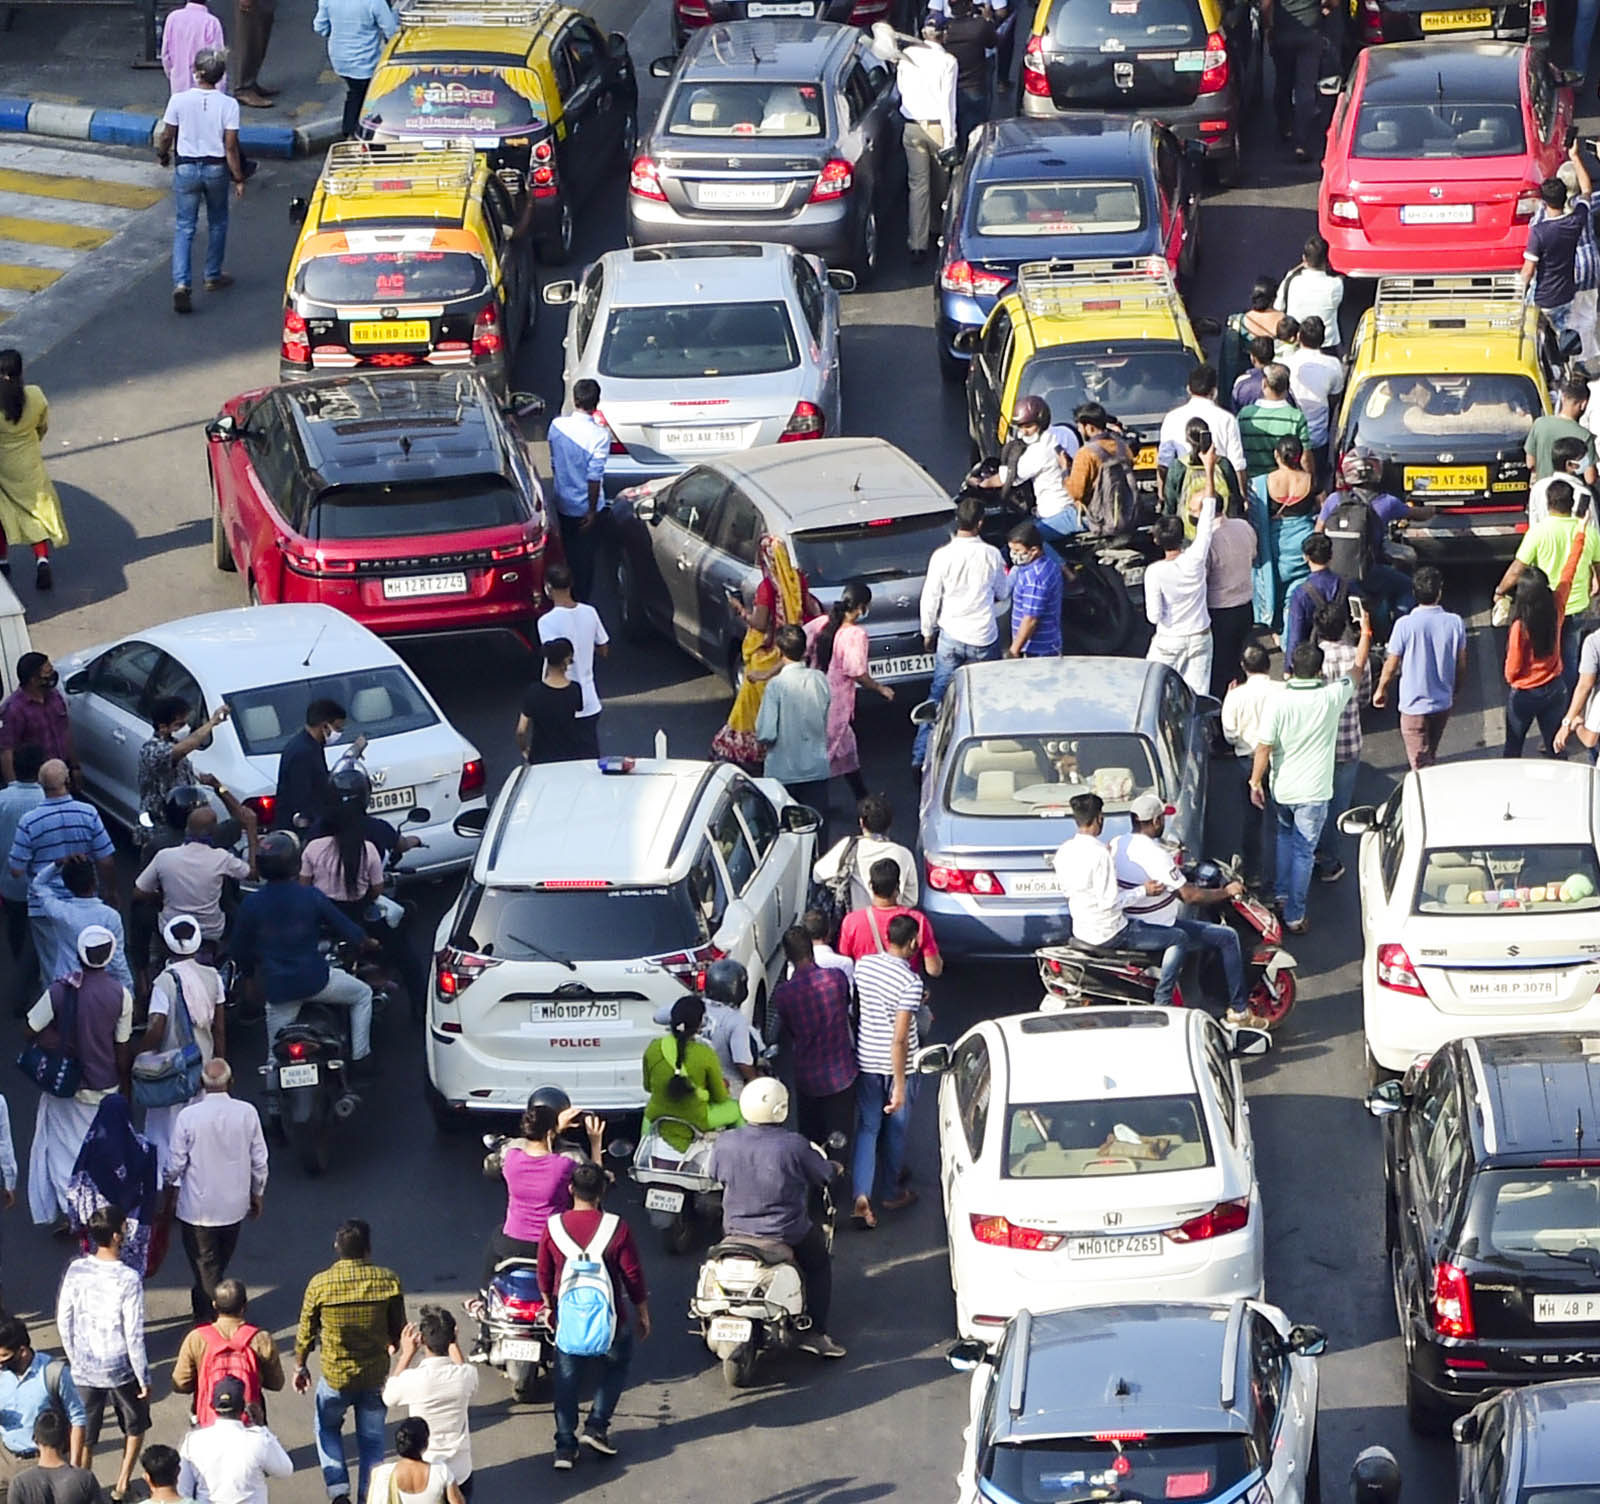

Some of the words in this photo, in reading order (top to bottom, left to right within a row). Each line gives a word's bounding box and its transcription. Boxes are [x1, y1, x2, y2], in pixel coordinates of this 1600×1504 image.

[667, 433, 680, 442] MH
[1443, 475, 1455, 485] AT
[360, 559, 420, 568] RANGE
[430, 552, 487, 564] ROVER
[549, 1038, 601, 1048] POLICE
[1539, 1305, 1555, 1317] MH
[1564, 1303, 1580, 1316] 48
[1586, 1301, 1594, 1314] P
